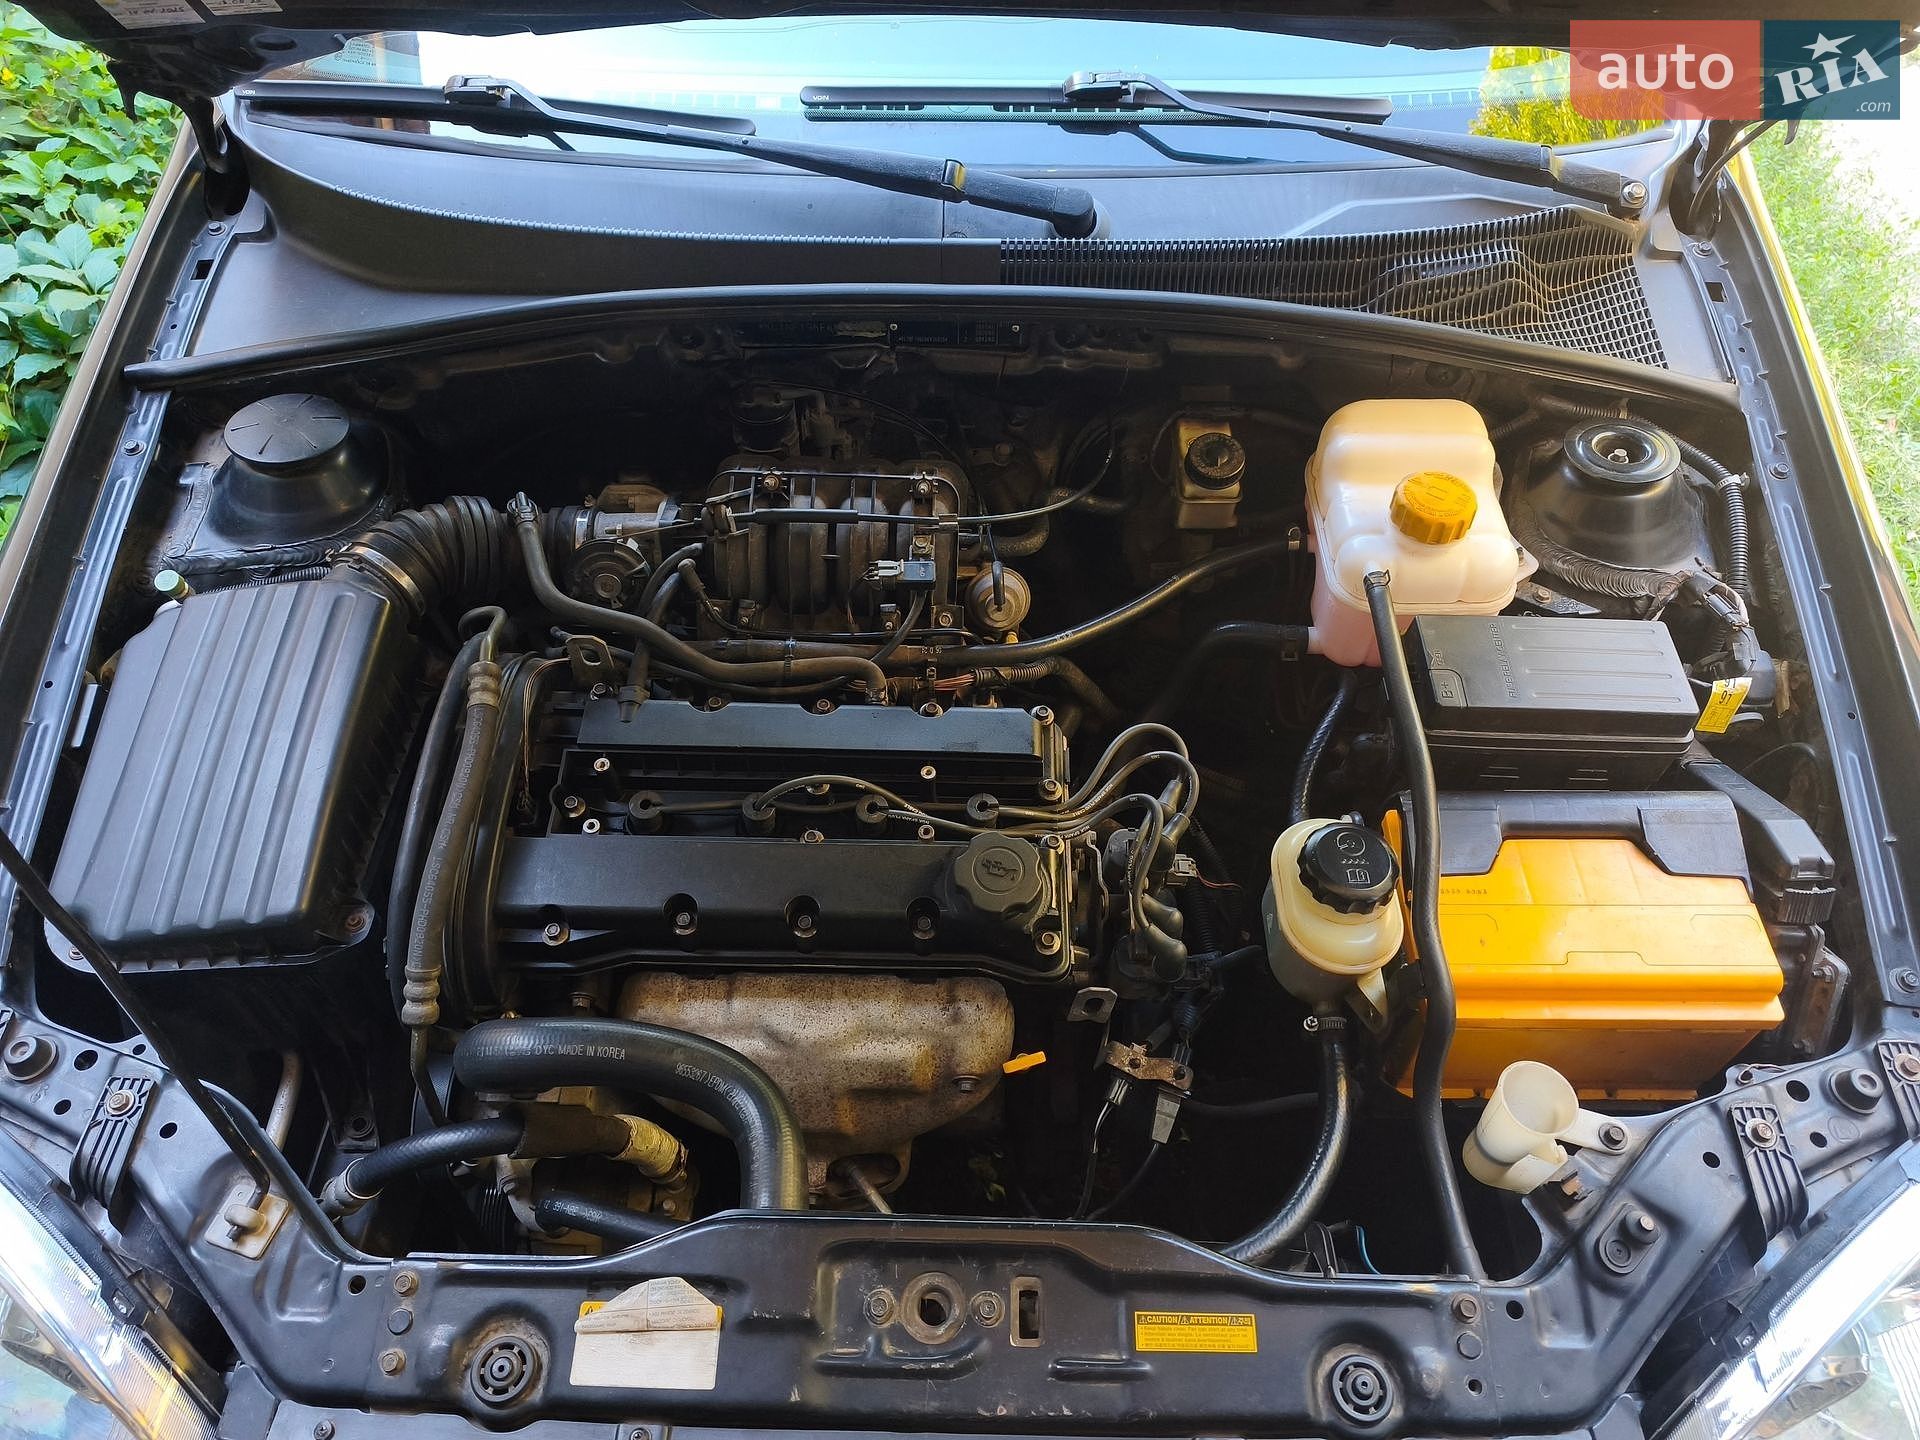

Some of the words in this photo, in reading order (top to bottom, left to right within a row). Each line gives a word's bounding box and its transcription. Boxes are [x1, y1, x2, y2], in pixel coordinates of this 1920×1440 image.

[558, 1044, 584, 1056] MADE
[586, 1045, 595, 1057] IN
[597, 1046, 625, 1060] KOREA
